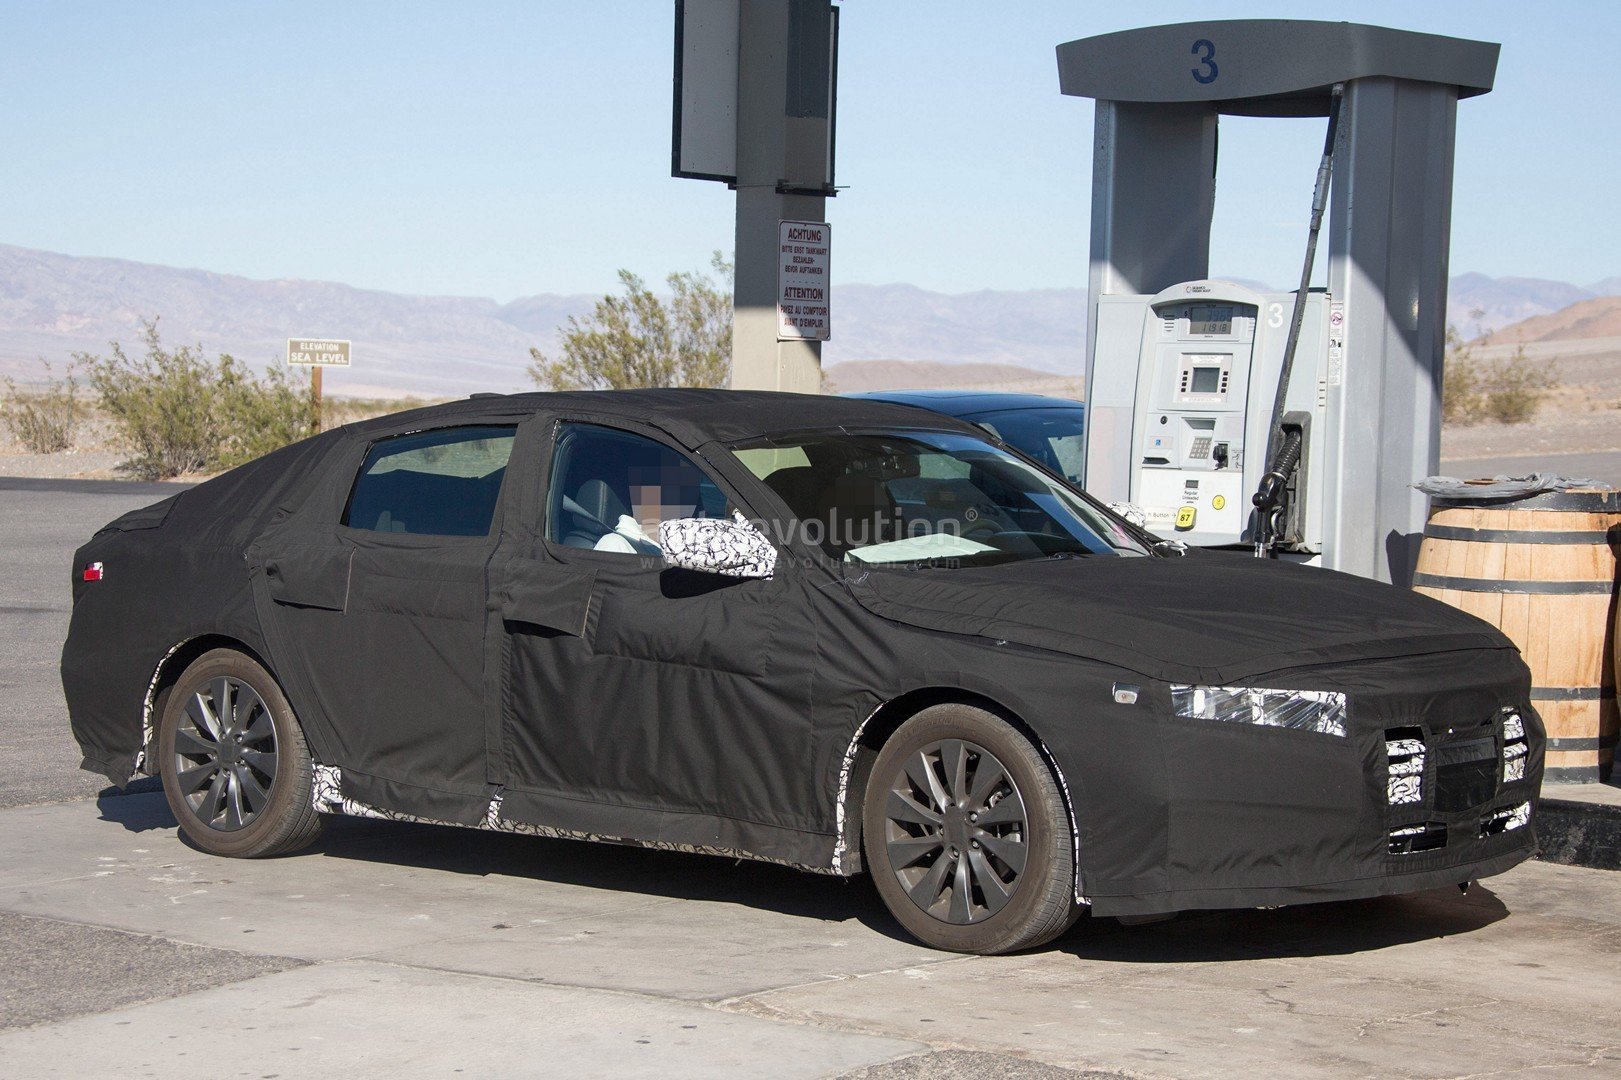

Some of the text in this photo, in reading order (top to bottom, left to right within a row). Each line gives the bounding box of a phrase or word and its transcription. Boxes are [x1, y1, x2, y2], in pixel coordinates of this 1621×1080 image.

[1191, 38, 1219, 84] 3
[787, 228, 822, 241] ACHTUNG
[784, 286, 824, 300] ATTENTION
[795, 304, 802, 315] AU
[1268, 302, 1284, 329] 3
[300, 342, 339, 351] ELEVATION
[290, 352, 348, 363] SEA LEVEL
[1180, 514, 1190, 522] 87
